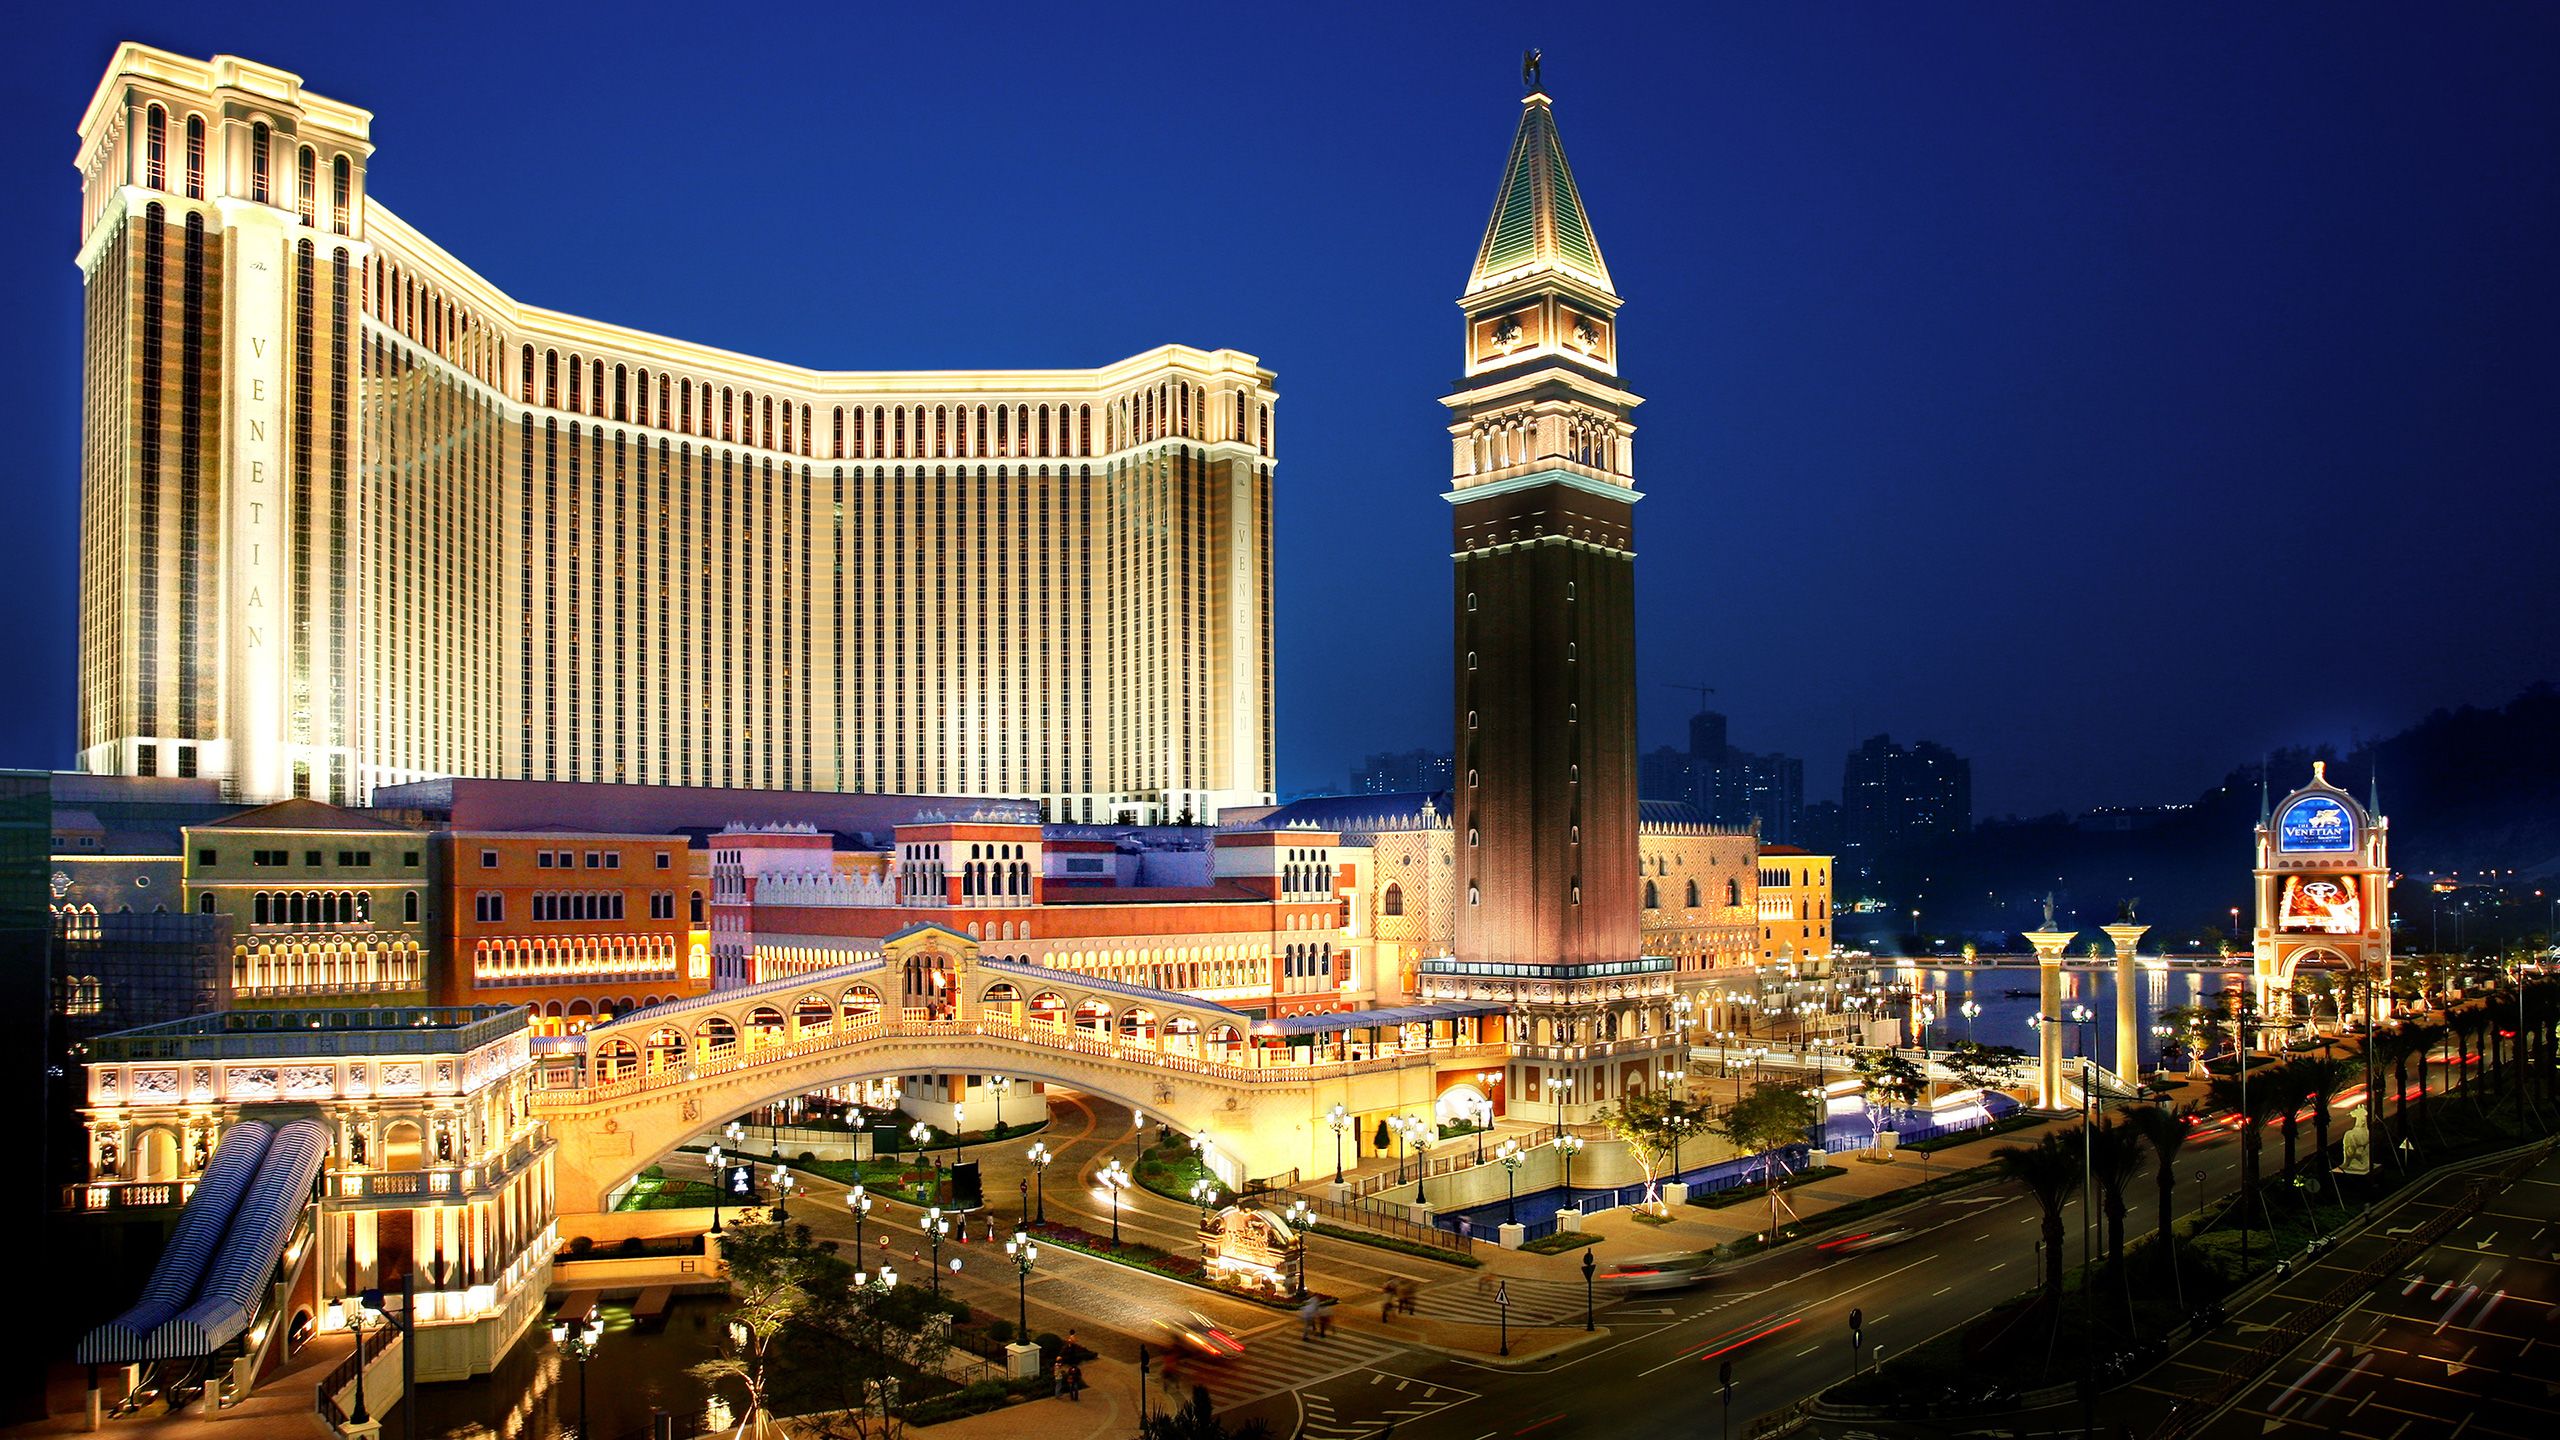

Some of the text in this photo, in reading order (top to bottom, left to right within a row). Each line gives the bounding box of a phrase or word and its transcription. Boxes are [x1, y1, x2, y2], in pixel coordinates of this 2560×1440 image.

[248, 337, 266, 648] VENETIAN
[1238, 529, 1247, 731] VENETIAN
[2285, 827, 2342, 837] VENETIAN
